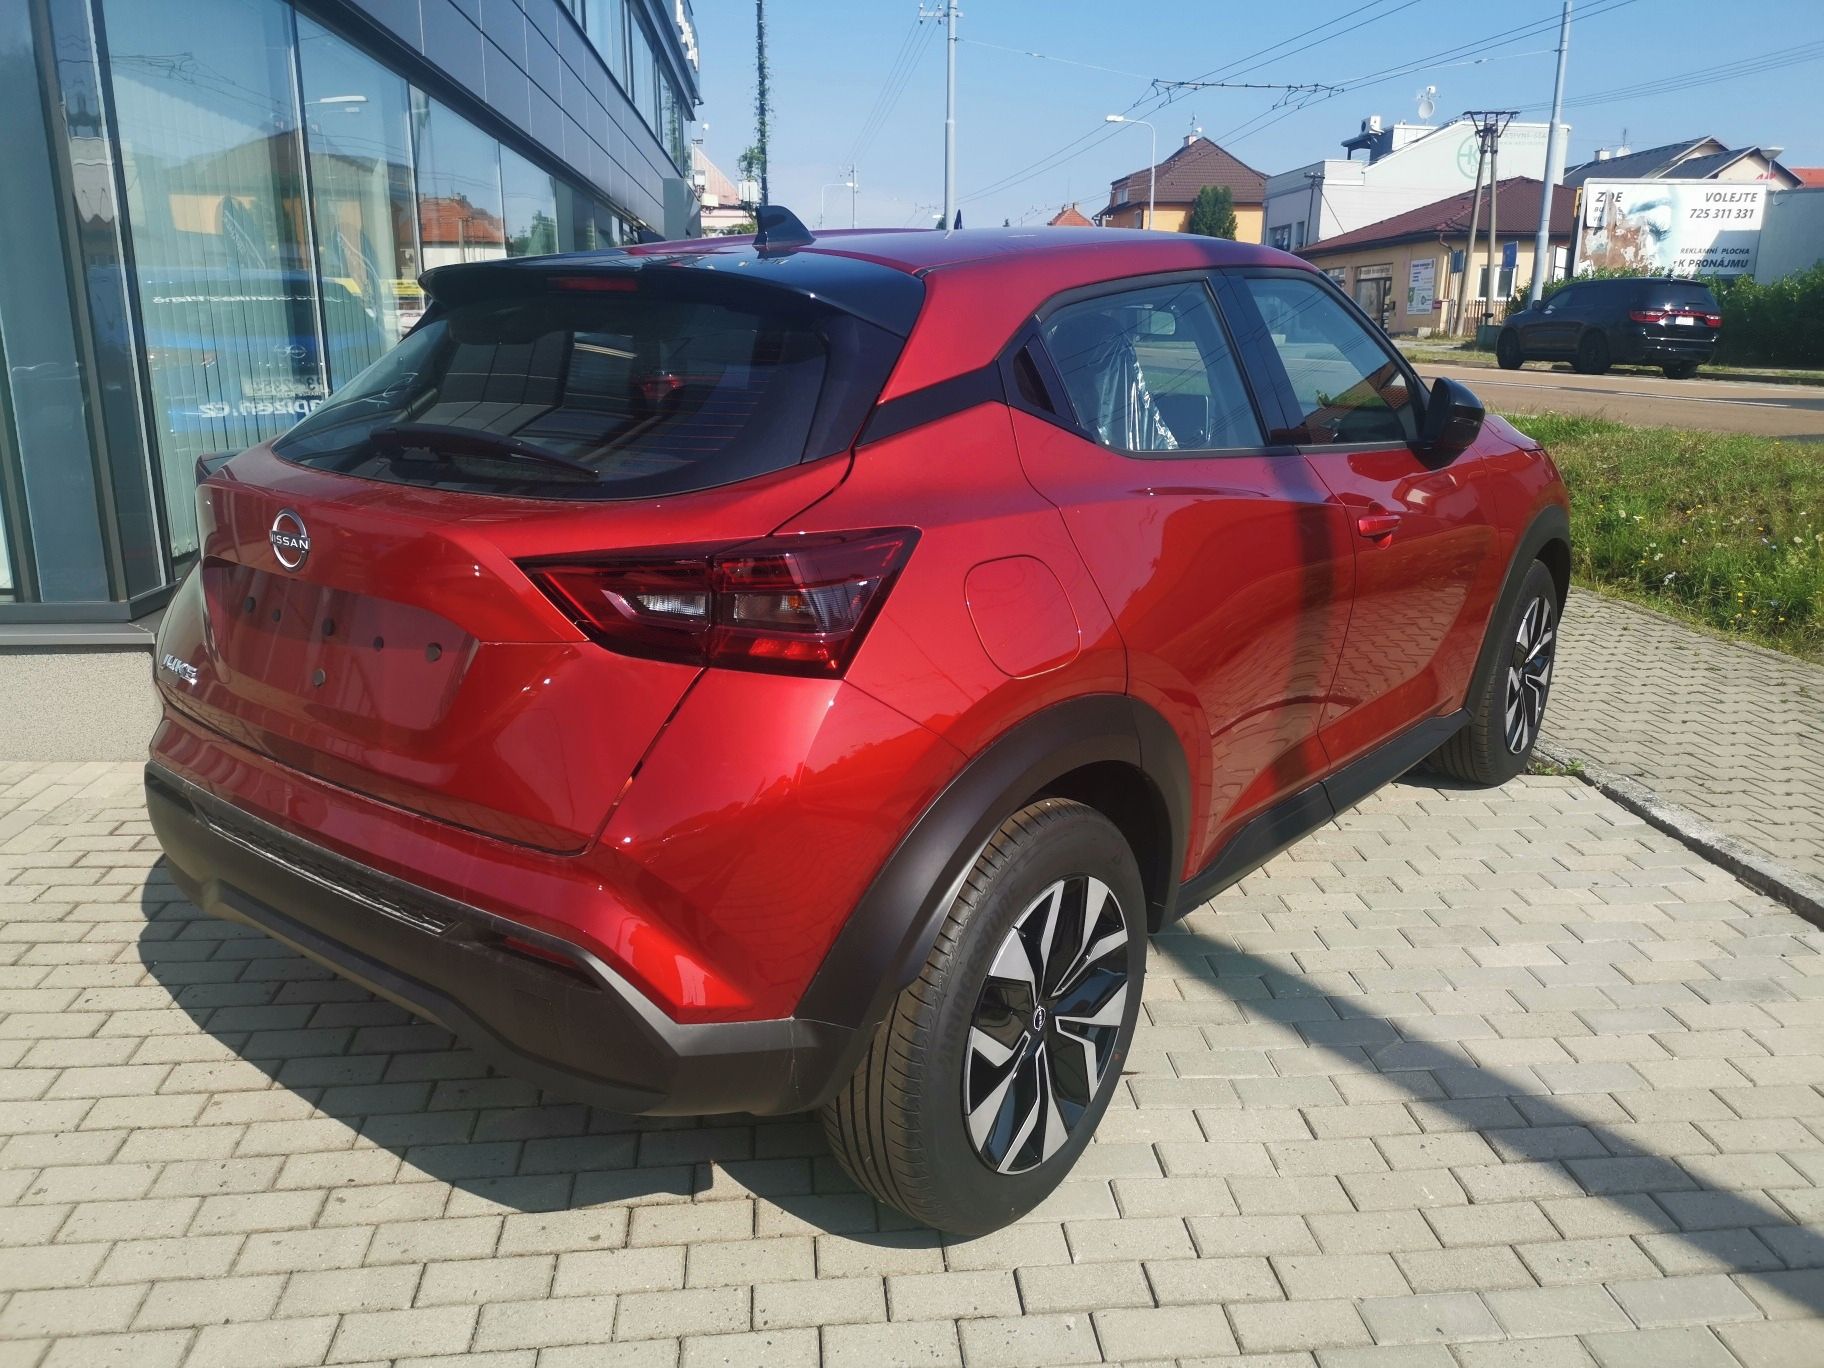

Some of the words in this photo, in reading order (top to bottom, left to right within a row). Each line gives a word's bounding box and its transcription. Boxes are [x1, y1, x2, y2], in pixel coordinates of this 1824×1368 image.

[1705, 192, 1758, 203] VOLEJTE
[1689, 208, 1711, 219] 725
[1712, 208, 1733, 219] 311
[1734, 208, 1754, 219] 331
[1680, 246, 1718, 255] REKLAMNÍ
[1677, 259, 1686, 268] K
[1688, 256, 1749, 268] PRONÁJMU
[271, 532, 309, 550] NISSAN
